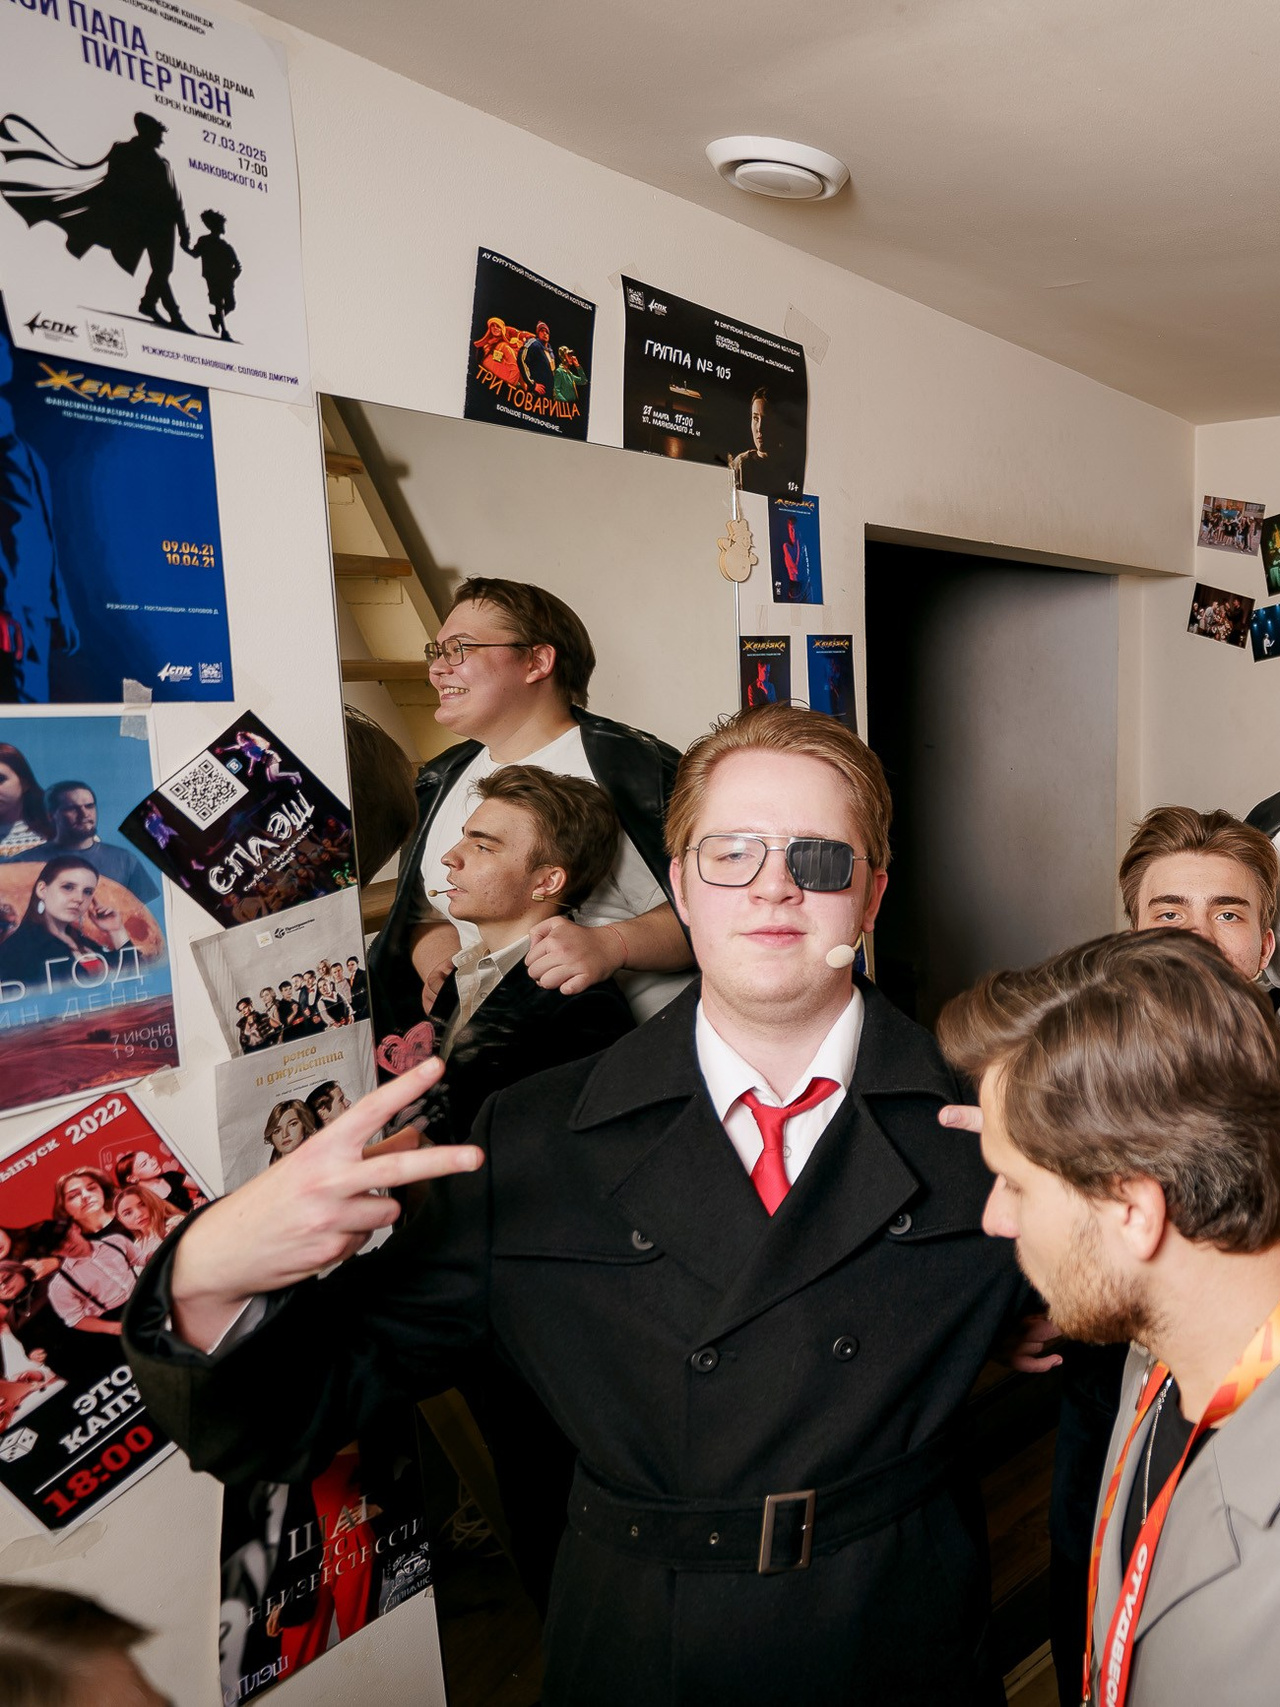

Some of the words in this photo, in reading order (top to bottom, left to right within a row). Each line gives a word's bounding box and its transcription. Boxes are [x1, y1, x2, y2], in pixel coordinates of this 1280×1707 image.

[69, 0, 149, 57] ПАПА
[81, 34, 172, 92] ПИТЕР
[180, 73, 232, 118] ПЭН
[155, 50, 221, 85] СОЦИАЛЬНАЯ
[222, 77, 256, 99] ДРАМА
[202, 130, 267, 163] 27.03.2025
[188, 158, 256, 189] МАЯКОВСКОГО
[257, 181, 268, 193] 41
[238, 157, 268, 178] 17:00
[42, 319, 78, 337] СПК
[644, 339, 691, 369] ГРУППА
[696, 357, 713, 373] №
[715, 365, 732, 380] 105
[475, 364, 504, 395] ТРИ
[507, 383, 581, 420] ТОВАРИЩА
[496, 403, 522, 418] БОЛЬШОЕ
[674, 413, 694, 428] 17:00
[787, 481, 799, 492] 12+
[161, 539, 214, 556] 09.04.21
[165, 553, 215, 568] 10.04.21
[208, 789, 316, 895] СПЛЭШ
[45, 946, 145, 995] ГОД
[62, 985, 150, 1022] ДЕНЬ
[109, 1033, 120, 1047] 7
[123, 1022, 171, 1045] ИЮНЯ
[64, 1097, 128, 1146] 2022
[72, 1364, 133, 1416] ЭТО
[42, 1425, 154, 1518] 18:00
[318, 1536, 353, 1570] ДО
